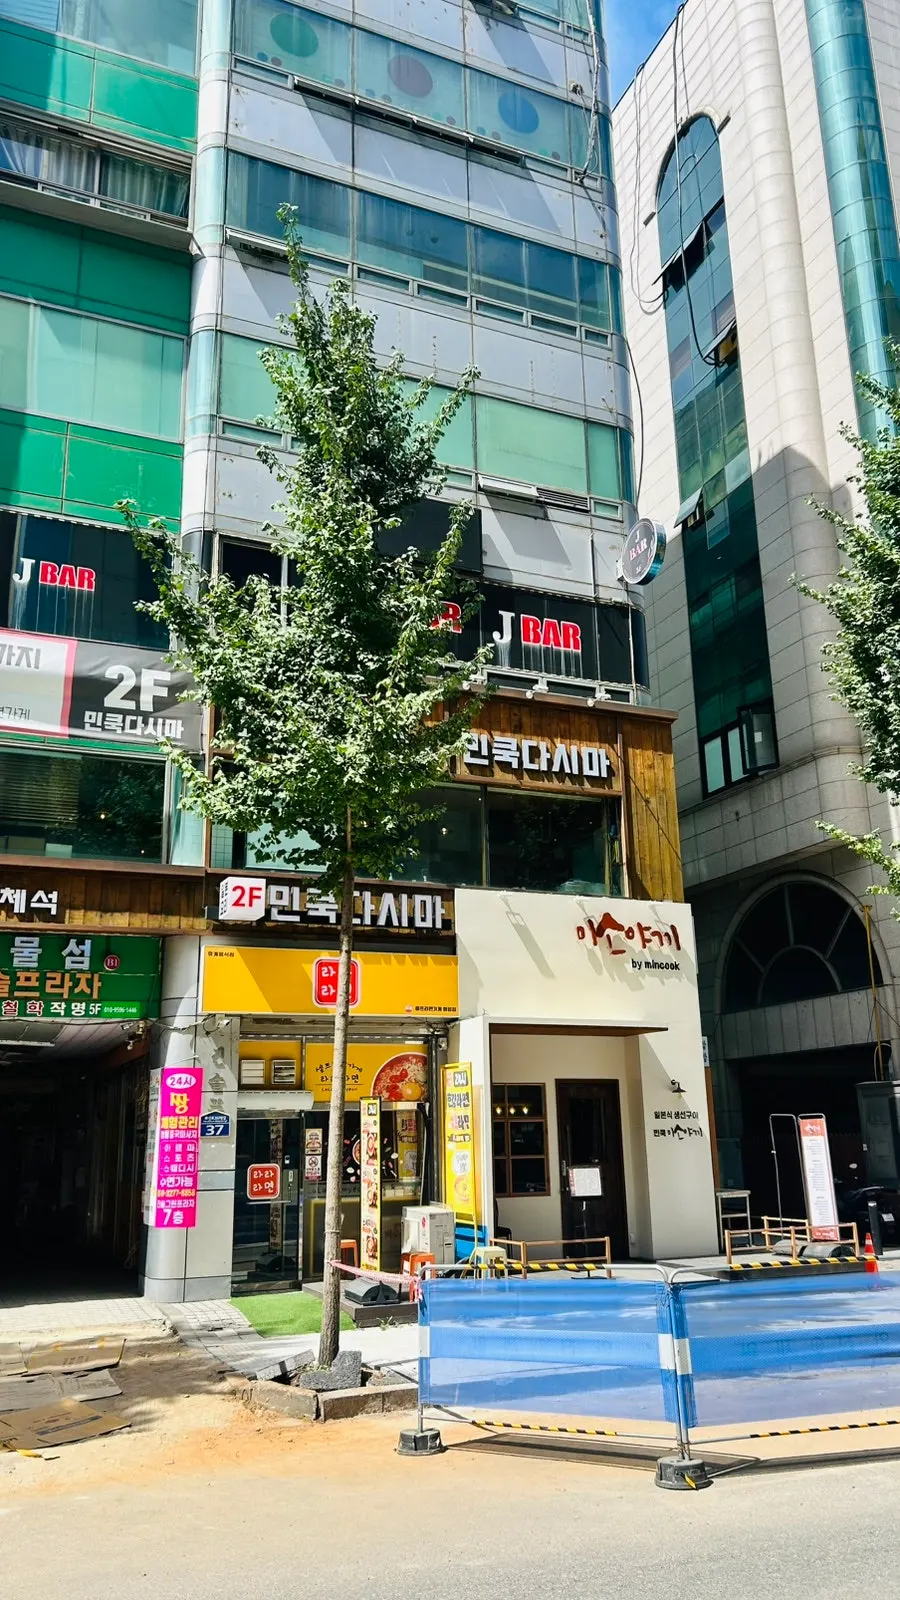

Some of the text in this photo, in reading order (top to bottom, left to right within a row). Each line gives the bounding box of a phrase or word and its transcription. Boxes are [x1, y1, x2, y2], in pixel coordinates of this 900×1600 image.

[629, 538, 648, 561] BAR
[12, 558, 96, 591] J BAR
[492, 610, 515, 645] J
[520, 614, 582, 652] BAR
[103, 664, 172, 713] 2F
[84, 710, 185, 739] 민쿡다시마
[463, 731, 610, 778] 민쿡다시마
[231, 885, 263, 908] 2F
[631, 958, 681, 971] by mincook
[170, 1077, 193, 1086] 24시
[205, 1124, 225, 1136] 37
[162, 1209, 184, 1225] 7층
